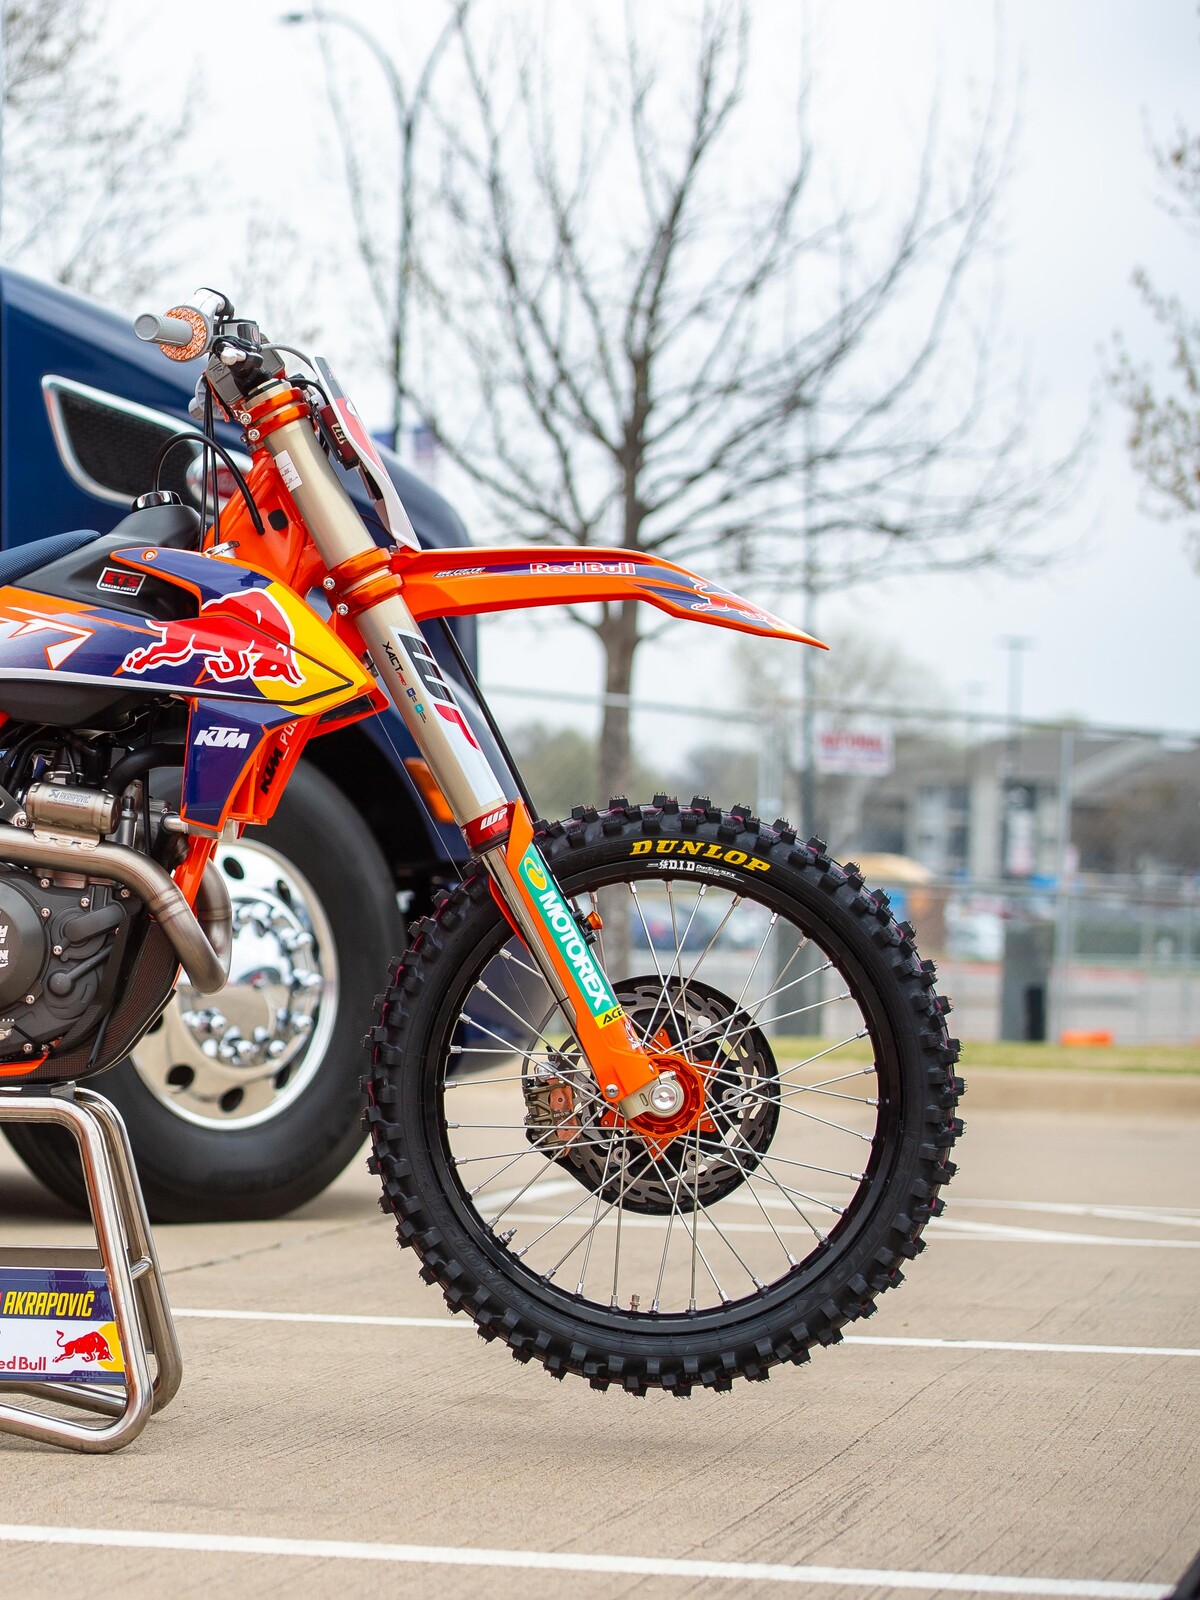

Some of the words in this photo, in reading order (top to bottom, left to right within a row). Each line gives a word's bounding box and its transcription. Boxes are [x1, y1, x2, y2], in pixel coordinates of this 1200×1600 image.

[103, 571, 140, 588] ETS
[531, 563, 580, 575] Red
[584, 563, 636, 575] Bull
[382, 641, 403, 671] XACT
[194, 726, 250, 749] KTM
[261, 747, 283, 795] KTM
[480, 807, 508, 831] WP
[629, 840, 771, 872] DUNLOP
[539, 890, 611, 1010] MOTOREX
[18, 1356, 46, 1371] Bull
